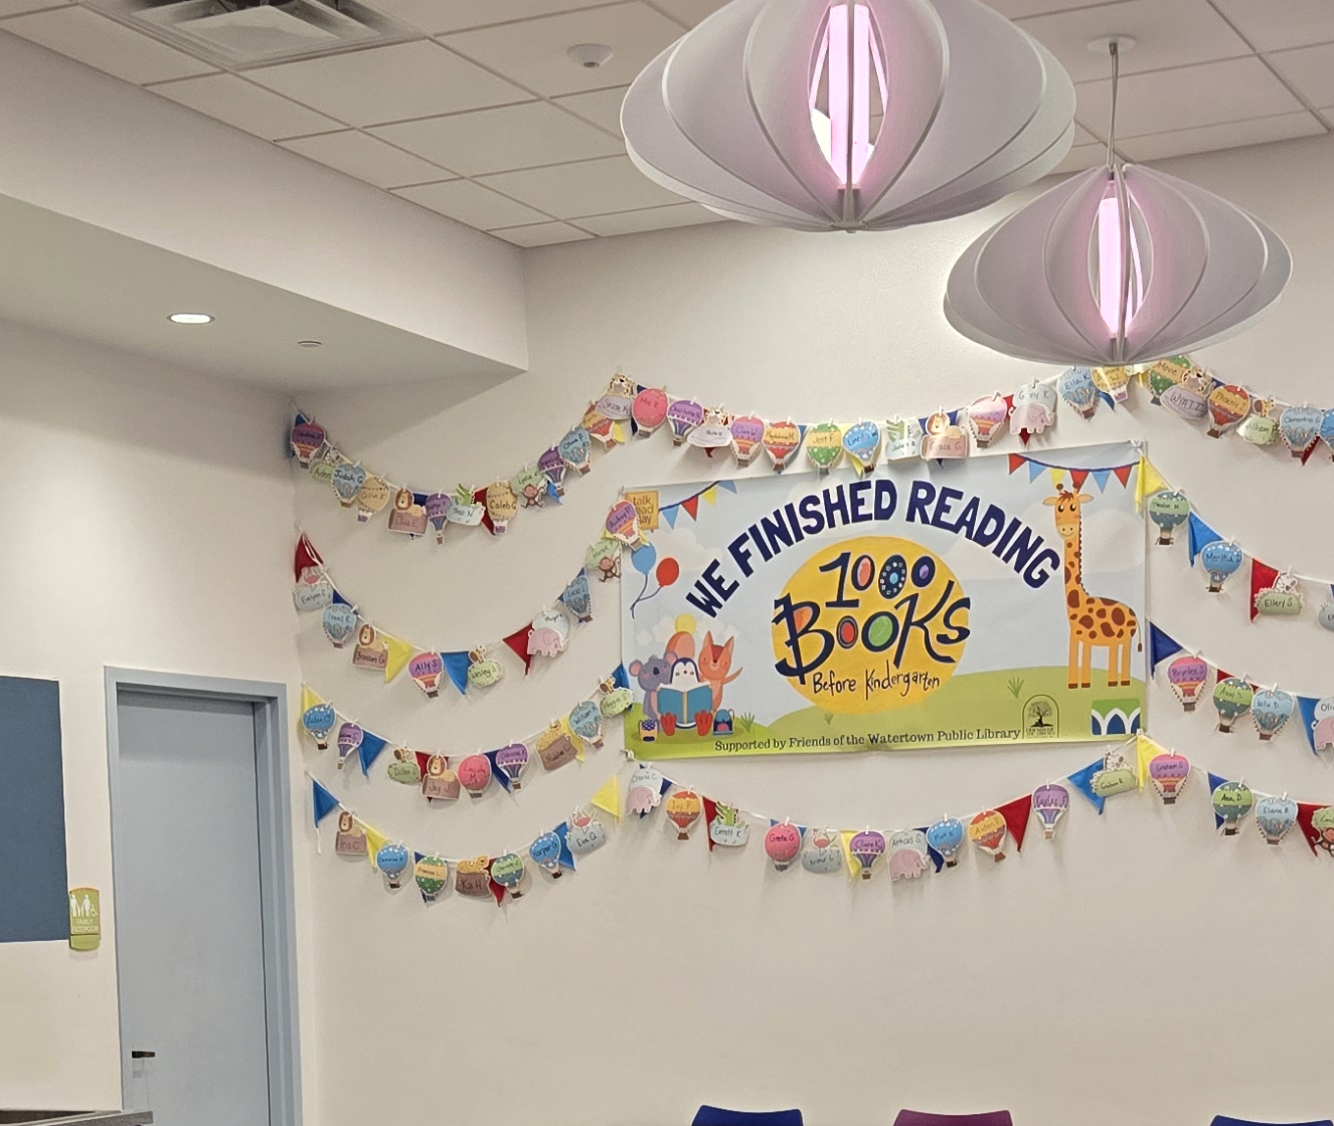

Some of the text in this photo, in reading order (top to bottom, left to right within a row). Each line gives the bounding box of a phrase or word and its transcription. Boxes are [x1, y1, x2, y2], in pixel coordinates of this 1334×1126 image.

[685, 479, 1061, 618] WE FINISHED READING
[819, 551, 937, 609] 1000
[812, 659, 941, 701] Before Kindergarten
[715, 738, 771, 752] Supported
[773, 738, 787, 750] by
[788, 736, 831, 749] Friends
[833, 735, 846, 747] of
[846, 735, 865, 746] the
[867, 731, 934, 745] Watertown
[937, 729, 974, 742] Public
[976, 728, 1021, 743] Library
